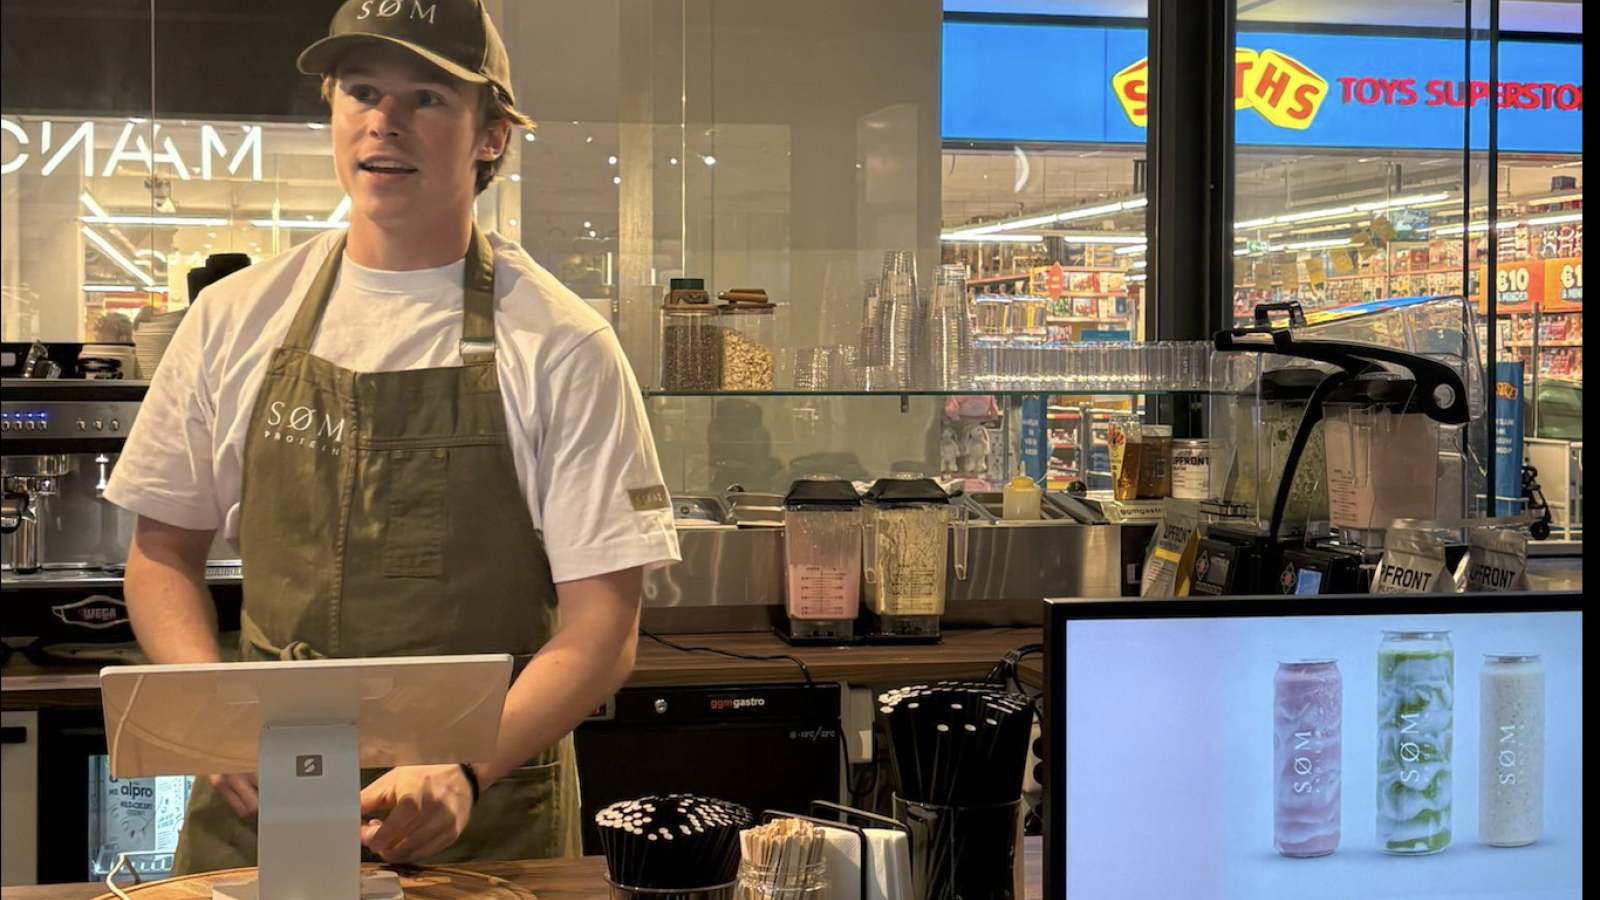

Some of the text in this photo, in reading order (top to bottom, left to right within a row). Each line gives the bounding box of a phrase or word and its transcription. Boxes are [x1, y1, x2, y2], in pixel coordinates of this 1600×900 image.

[357, 0, 436, 24] SØM
[1123, 60, 1321, 121] STHS
[1338, 77, 1582, 112] TOYS SUPERSTO
[1497, 267, 1529, 293] €10
[267, 401, 345, 442] SØM
[264, 430, 340, 456] PROTEIN
[83, 607, 117, 621] WEGA
[710, 697, 765, 710] ggmgastro
[1293, 731, 1312, 793] SØM
[1400, 713, 1419, 782] SØM
[1499, 725, 1516, 785] SØM
[120, 781, 154, 801] alpro
